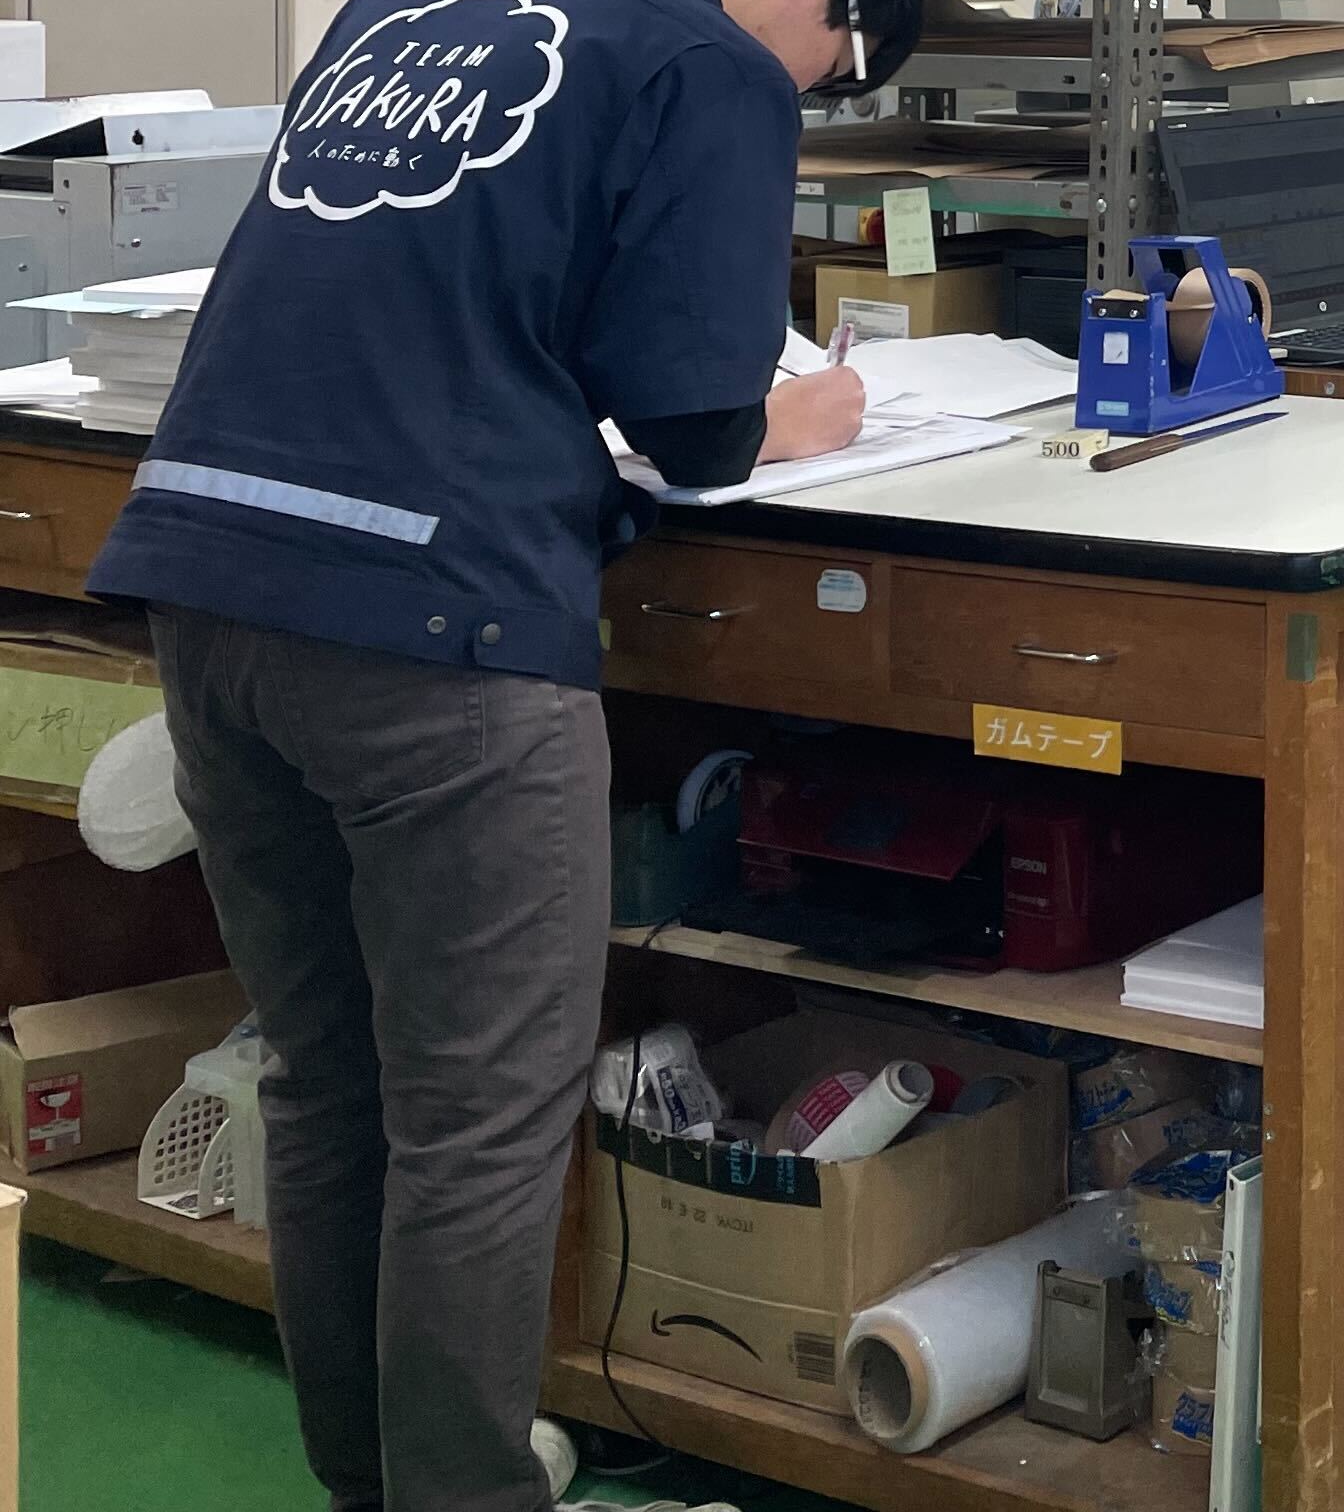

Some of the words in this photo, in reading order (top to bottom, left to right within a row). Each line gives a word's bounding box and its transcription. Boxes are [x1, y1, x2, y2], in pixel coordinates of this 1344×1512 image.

[393, 41, 495, 67] TEAM
[297, 54, 488, 143] SAKURA
[1042, 441, 1080, 457] 500
[986, 717, 1113, 758] ガムテープ
[1011, 856, 1048, 875] EPSON
